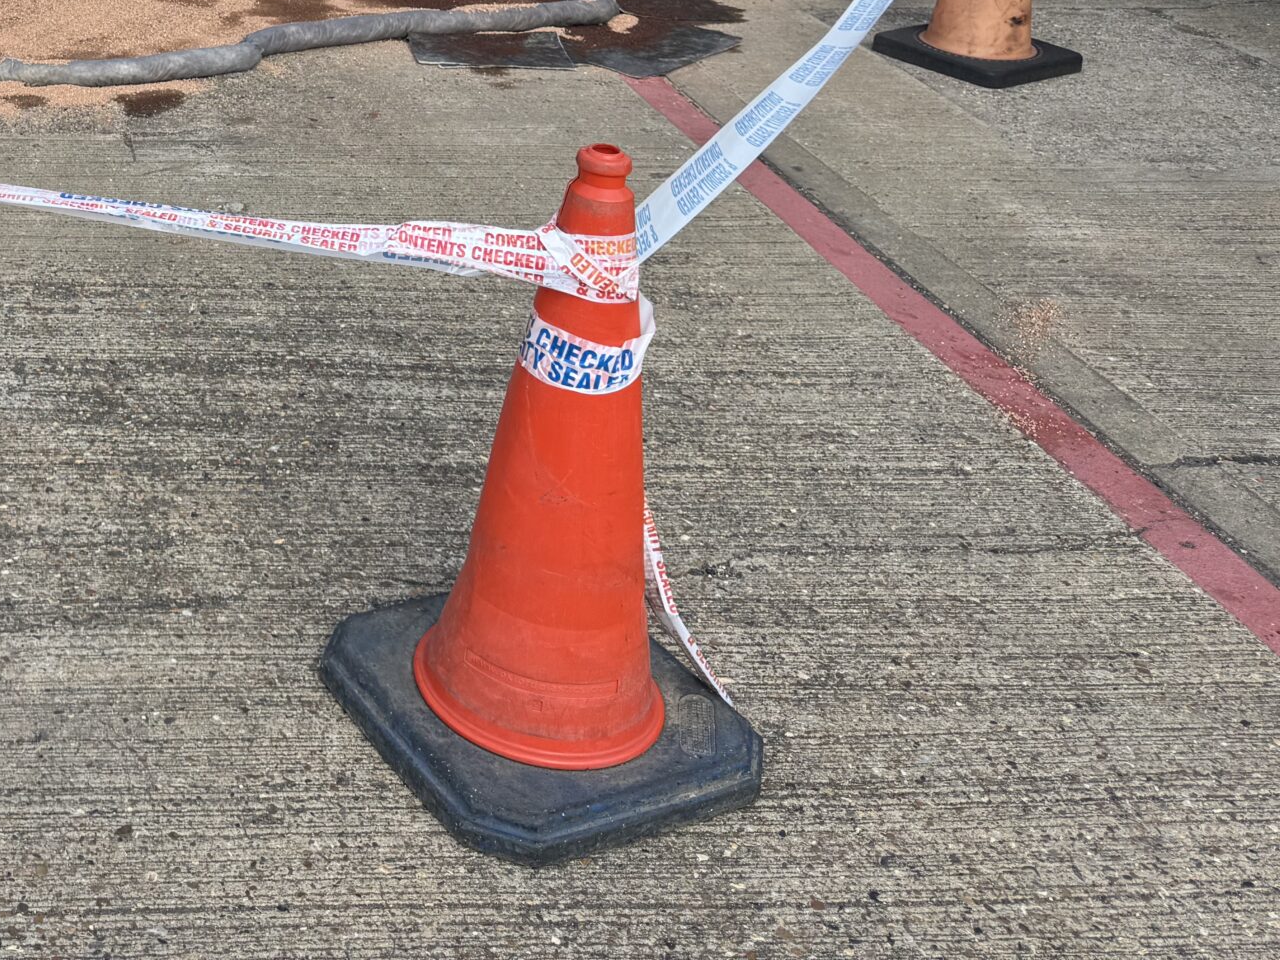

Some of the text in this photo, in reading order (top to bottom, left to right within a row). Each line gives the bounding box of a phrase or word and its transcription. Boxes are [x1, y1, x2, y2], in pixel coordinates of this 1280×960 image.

[223, 221, 295, 240] SECURITY
[290, 224, 361, 241] CHECKED
[471, 245, 546, 271] CHECKED
